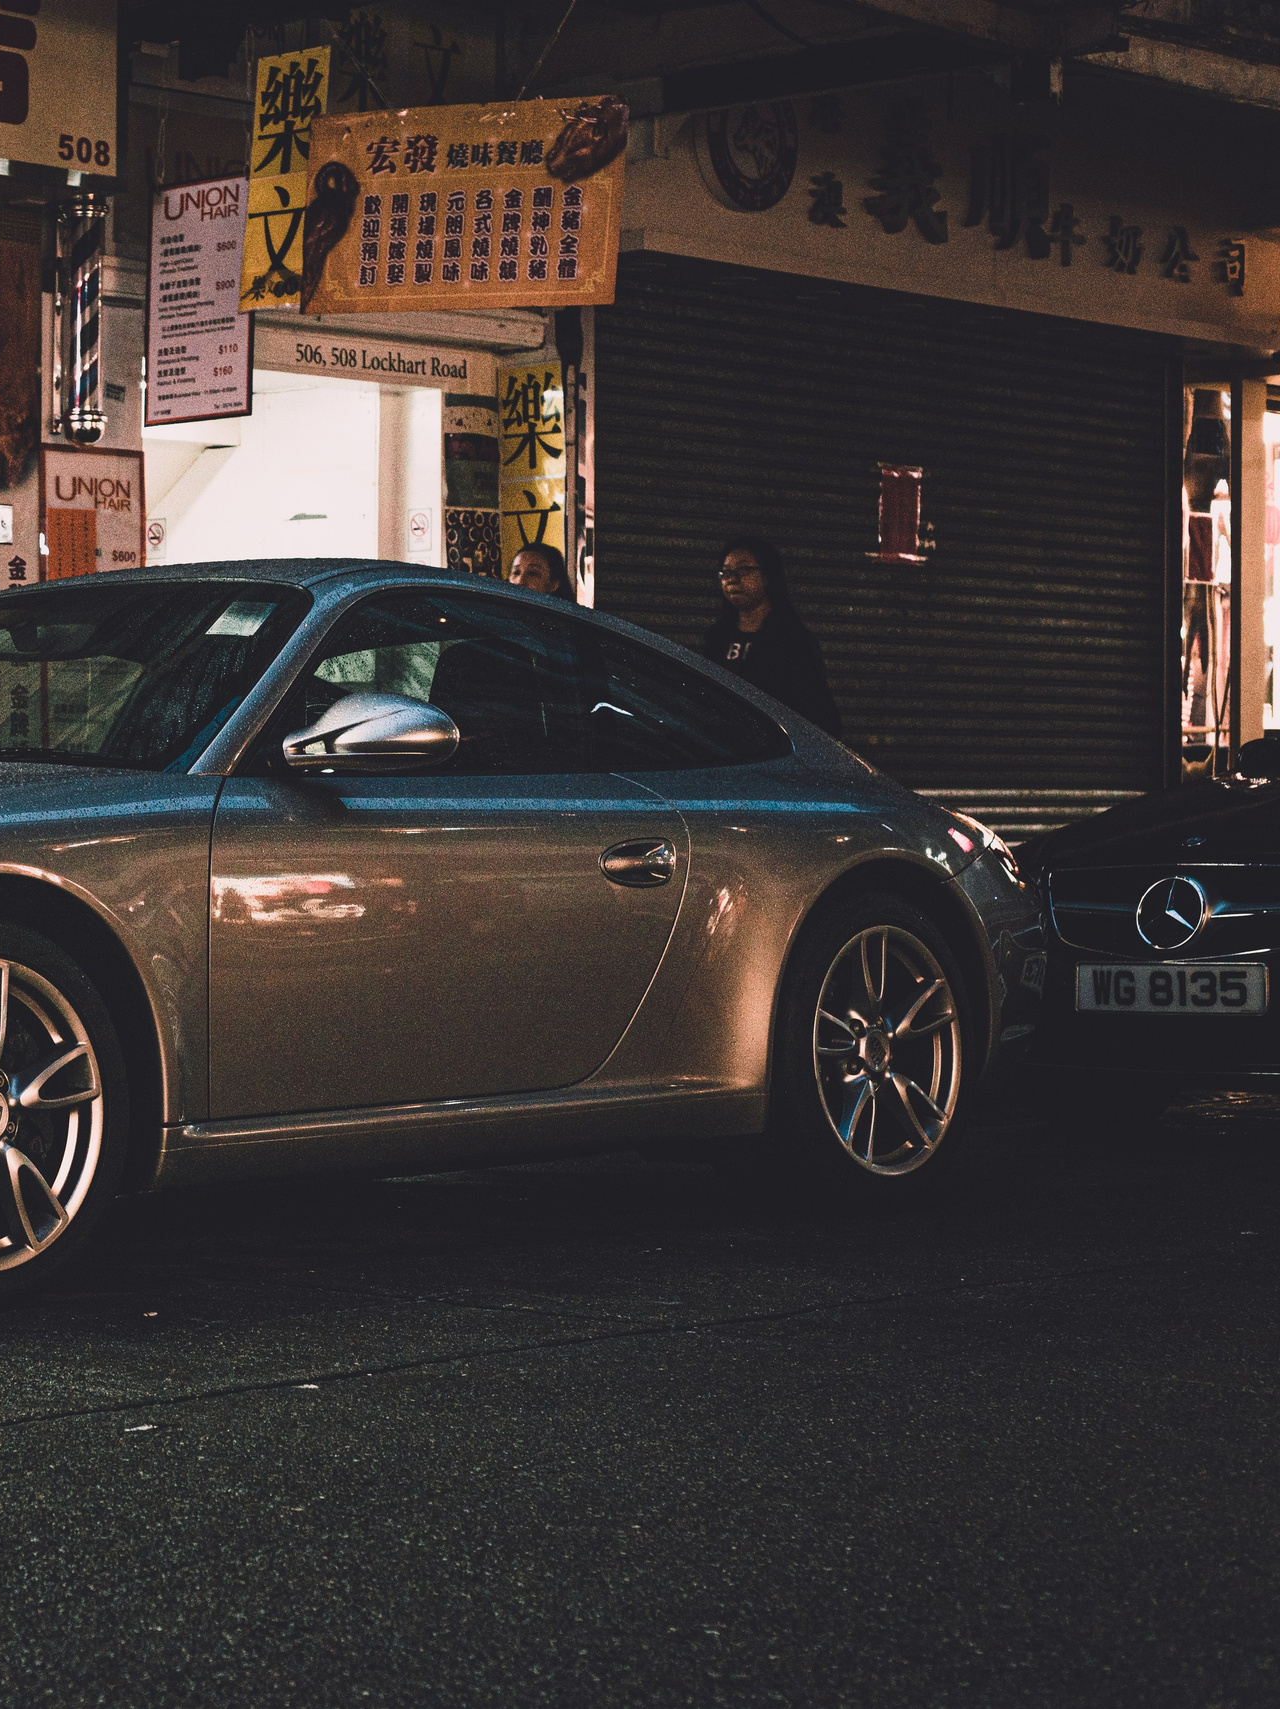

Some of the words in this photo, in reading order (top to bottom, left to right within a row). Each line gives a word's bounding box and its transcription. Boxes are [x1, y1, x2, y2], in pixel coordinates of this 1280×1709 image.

[58, 134, 111, 167] 508
[366, 135, 439, 175] 宏發
[446, 139, 544, 169] 燒味餐廳
[244, 58, 324, 284] 樂文
[164, 184, 240, 221] UNION
[200, 204, 240, 222] HAIR
[441, 190, 465, 282] 元朗風味
[470, 189, 494, 281] 各式燒味
[218, 343, 239, 355] $110
[296, 343, 327, 367] 506,
[331, 346, 358, 368] 508
[361, 350, 427, 376] Lockhart
[431, 357, 468, 380] Road
[213, 365, 234, 377] $160
[55, 475, 132, 502] UNION
[94, 499, 132, 512] HAIR
[1092, 969, 1136, 1006] WG
[1149, 970, 1248, 1007] 8135
